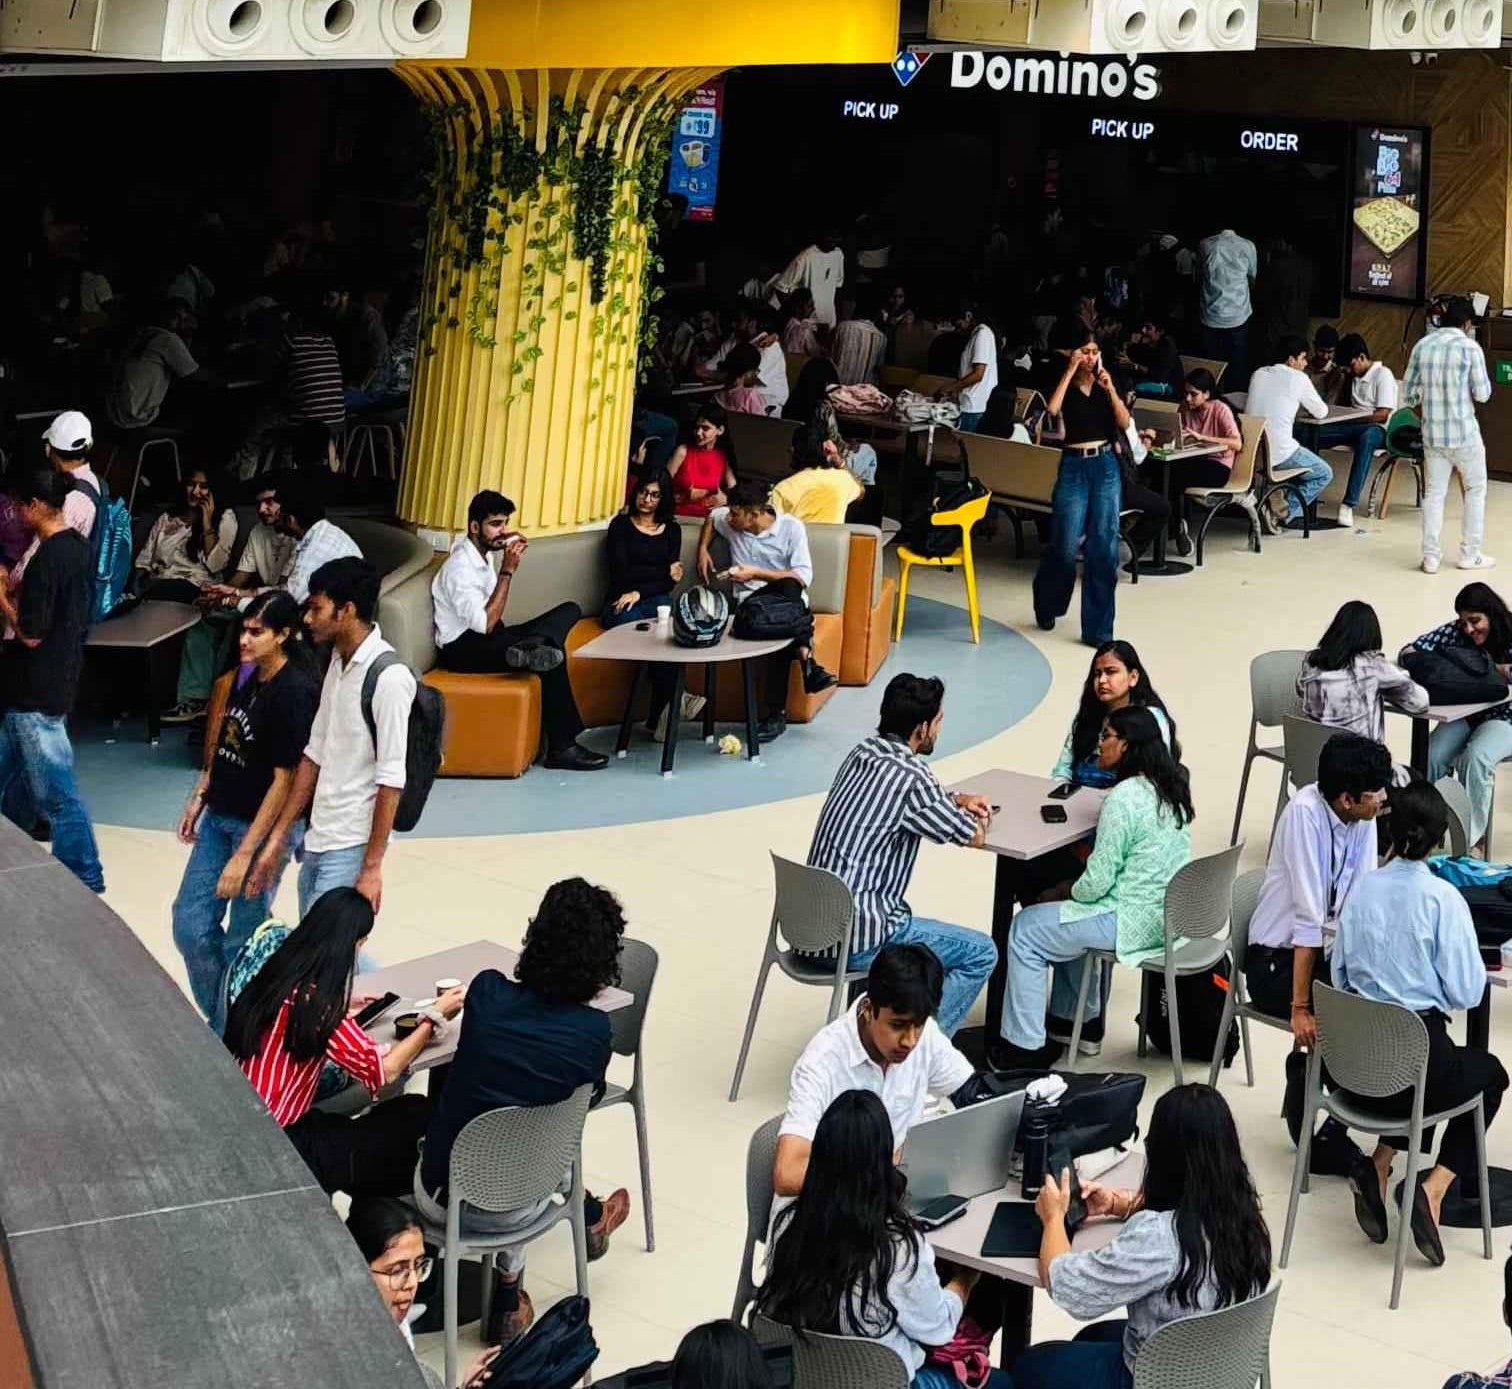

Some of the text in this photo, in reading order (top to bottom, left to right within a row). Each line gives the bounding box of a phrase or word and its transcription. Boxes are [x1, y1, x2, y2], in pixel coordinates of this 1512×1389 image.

[951, 50, 1159, 101] Domino's
[843, 100, 899, 120] PICK UP
[1091, 118, 1154, 140] PICK UP
[1240, 130, 1299, 152] ORDER
